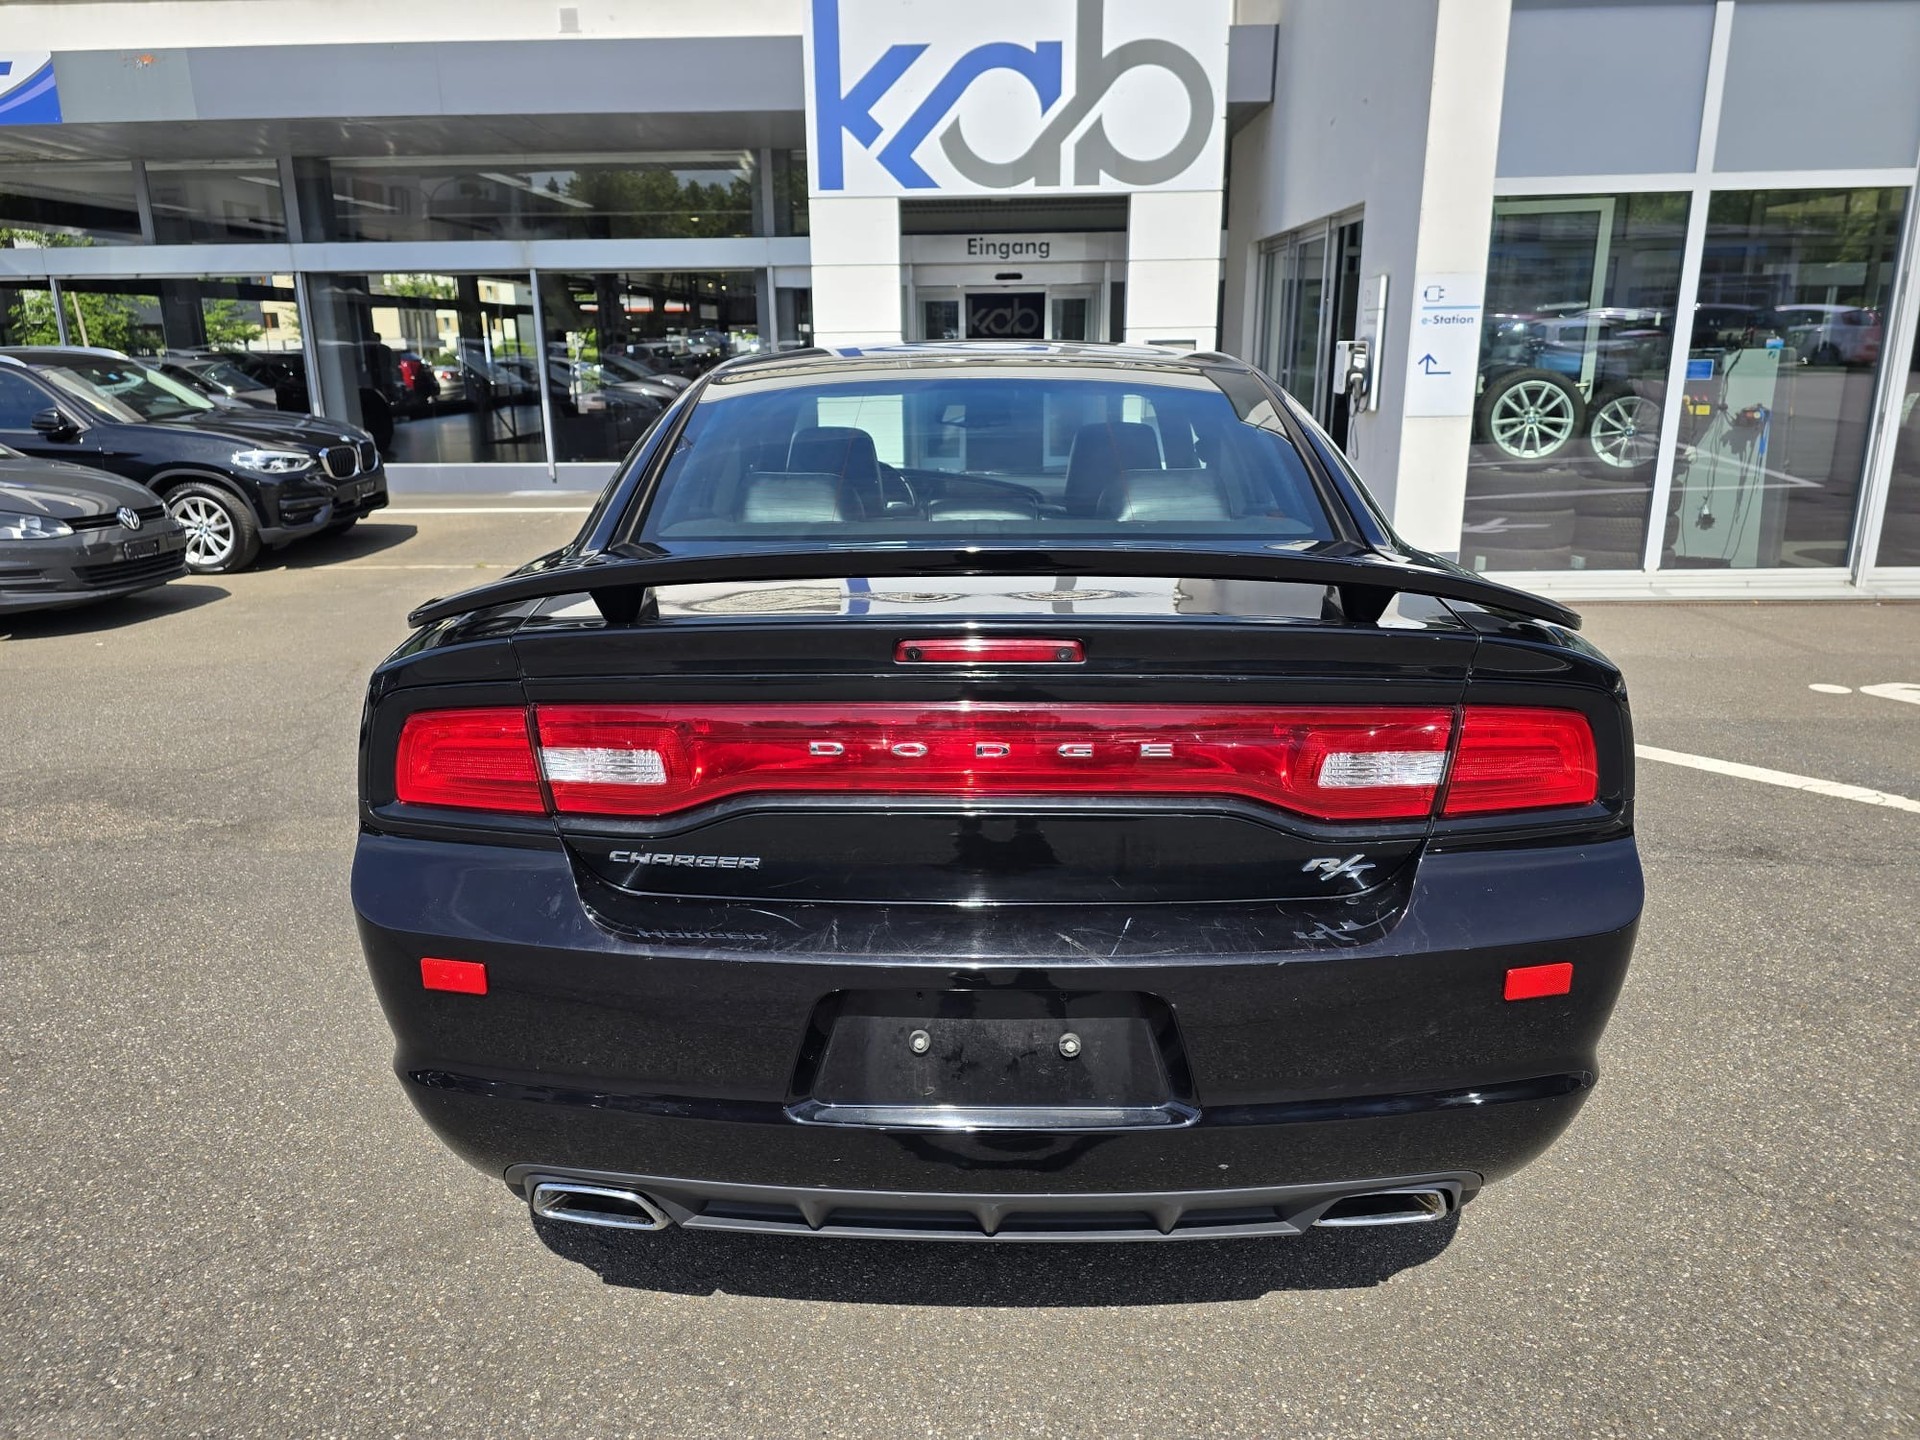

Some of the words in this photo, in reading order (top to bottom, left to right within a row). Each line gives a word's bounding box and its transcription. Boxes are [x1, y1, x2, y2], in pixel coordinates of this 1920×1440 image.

[812, 0, 1214, 190] kab
[967, 238, 1050, 259] Eingang
[1421, 314, 1475, 325] e-Station
[809, 742, 1173, 758] DODGE
[609, 850, 761, 870] CHARGER
[1301, 854, 1377, 880] R/T
